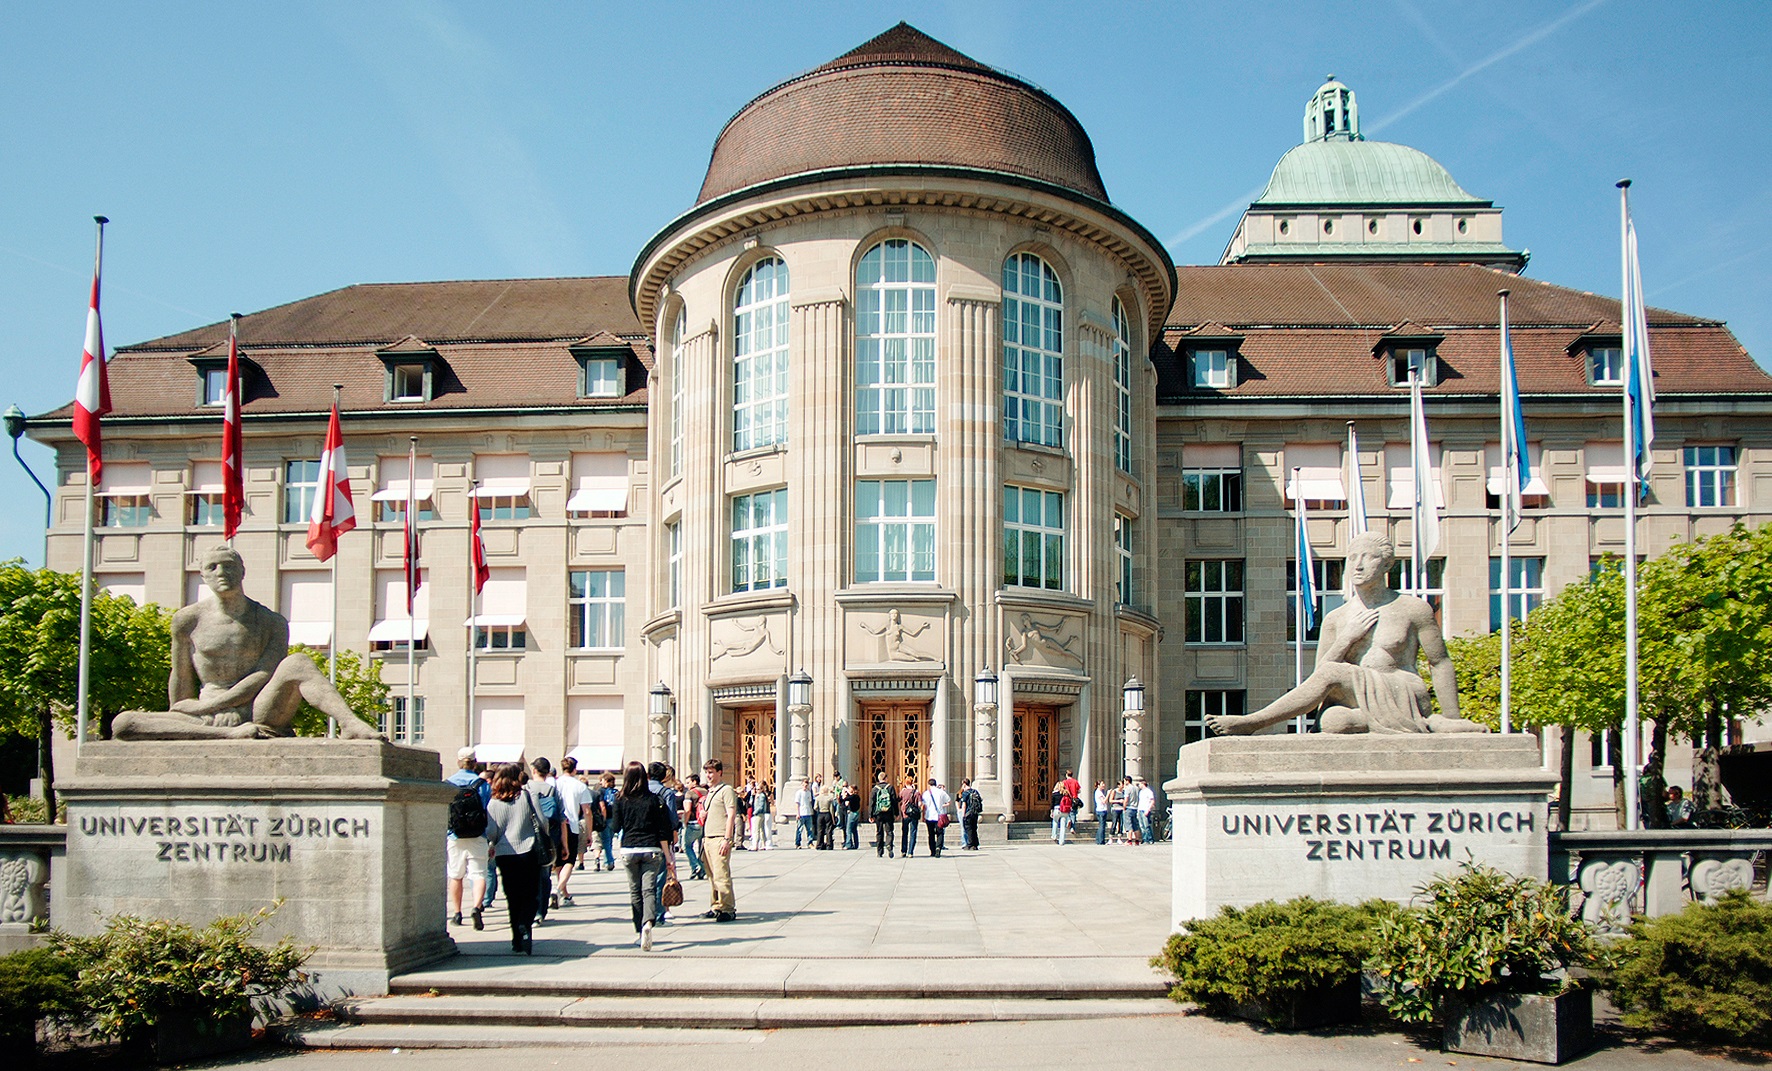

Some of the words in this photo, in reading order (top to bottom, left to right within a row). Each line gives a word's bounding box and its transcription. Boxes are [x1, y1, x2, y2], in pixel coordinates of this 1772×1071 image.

[80, 813, 259, 837] UNIVERSITÄT
[268, 813, 369, 838] ZÜRICH
[1222, 809, 1416, 835] UNIVERSITÄT
[1427, 808, 1534, 833] ZÜRICH
[155, 841, 292, 862] ZENTRUM
[1306, 839, 1451, 861] ZENTRUM
